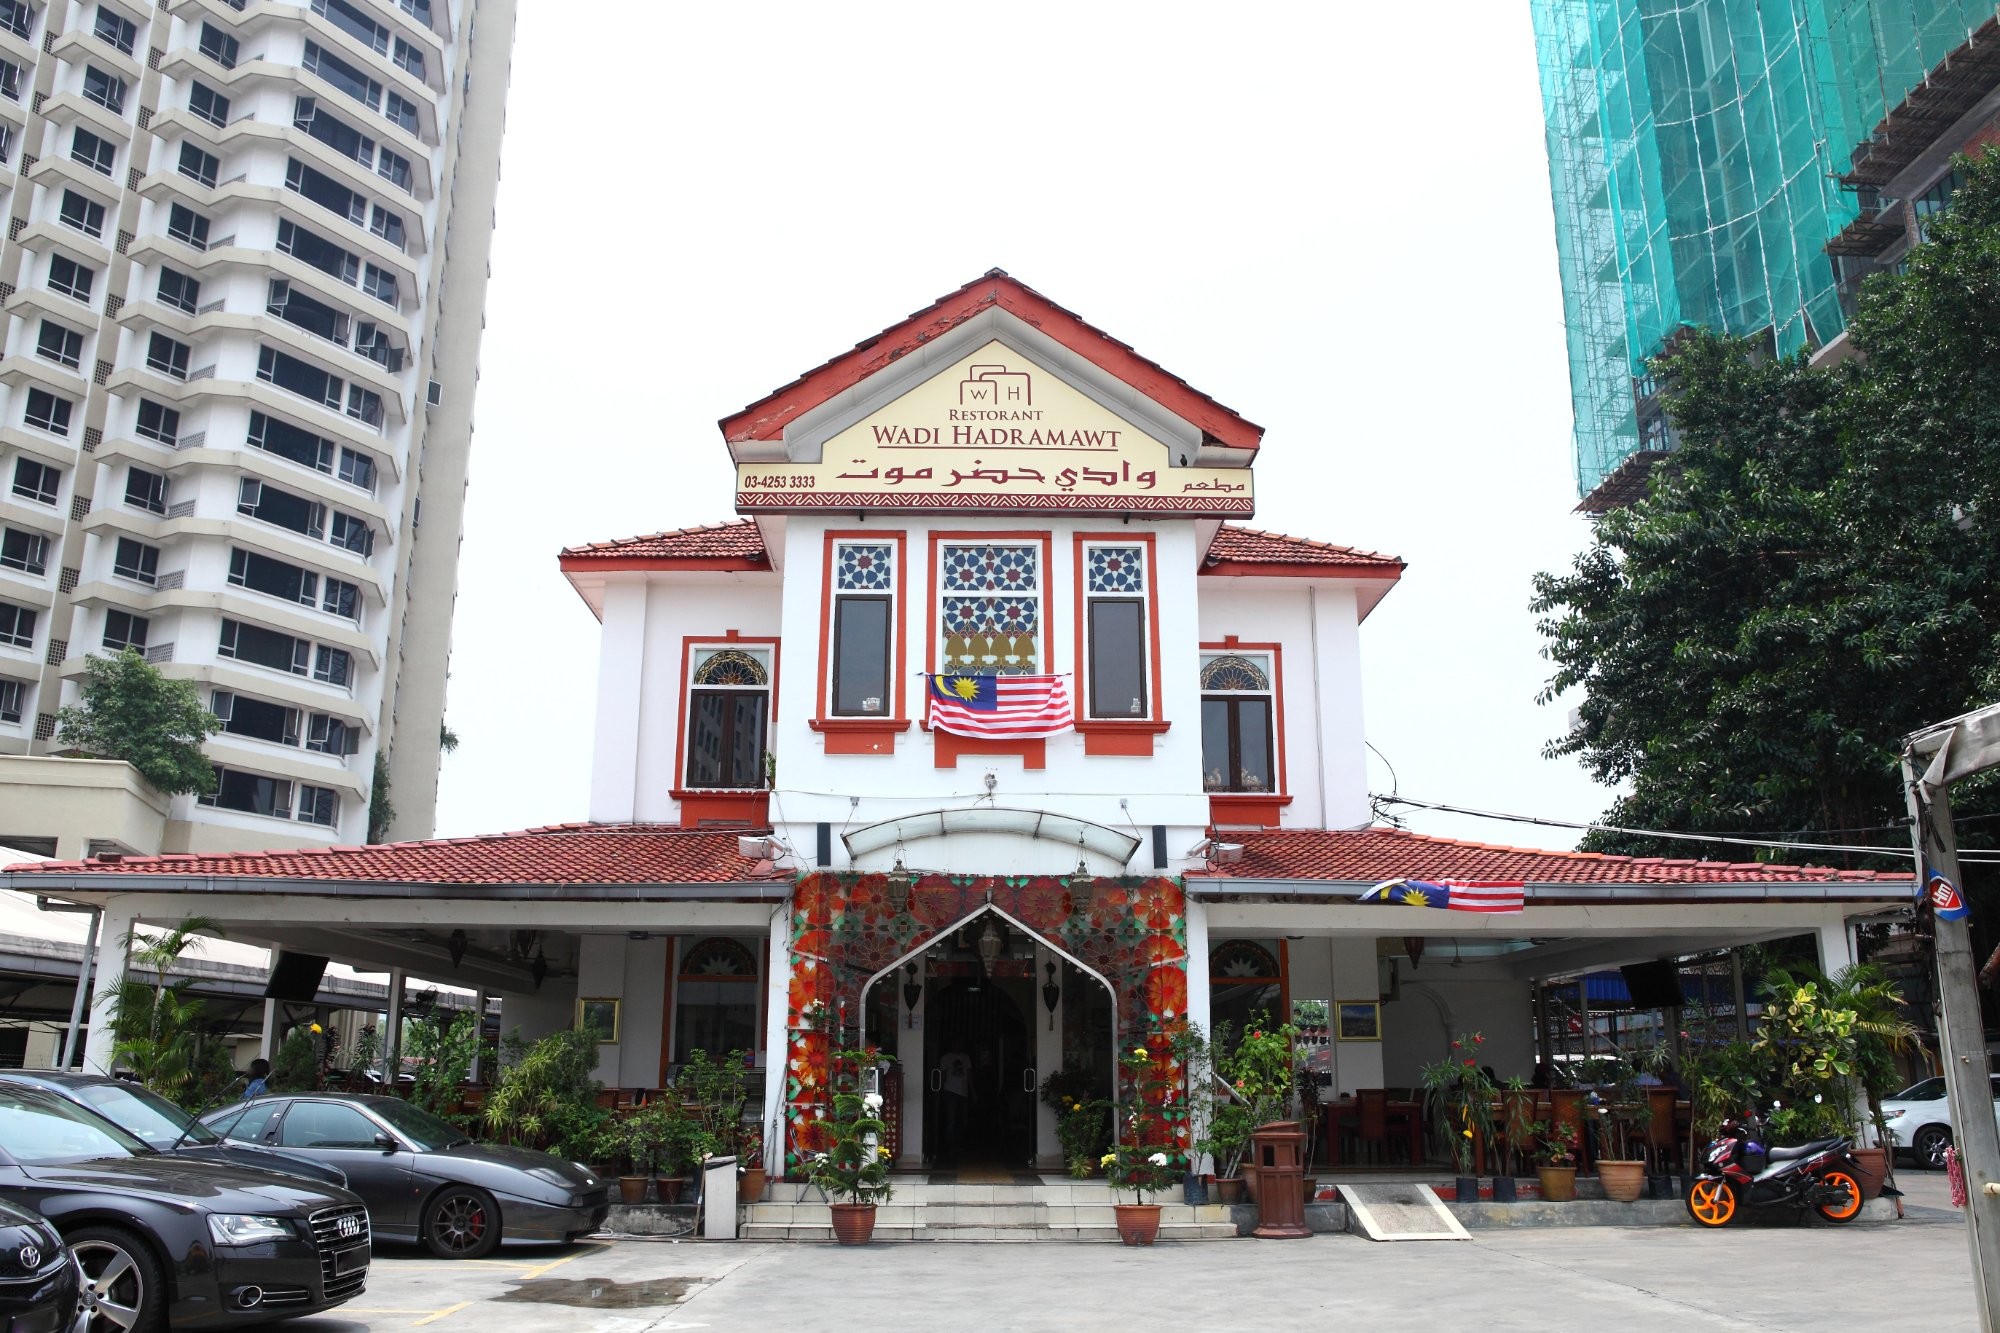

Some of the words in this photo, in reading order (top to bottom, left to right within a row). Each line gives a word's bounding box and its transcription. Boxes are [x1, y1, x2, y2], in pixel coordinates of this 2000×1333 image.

[970, 388, 988, 401] W
[1007, 386, 1020, 401] H
[949, 409, 1044, 421] RESTORANT
[871, 425, 941, 445] WADI
[951, 425, 1122, 448] HADRAMAWT
[744, 475, 787, 489] 03-4253
[789, 475, 816, 489] 3333
[1054, 459, 1156, 492] وادي
[1182, 477, 1245, 493] مطعم
